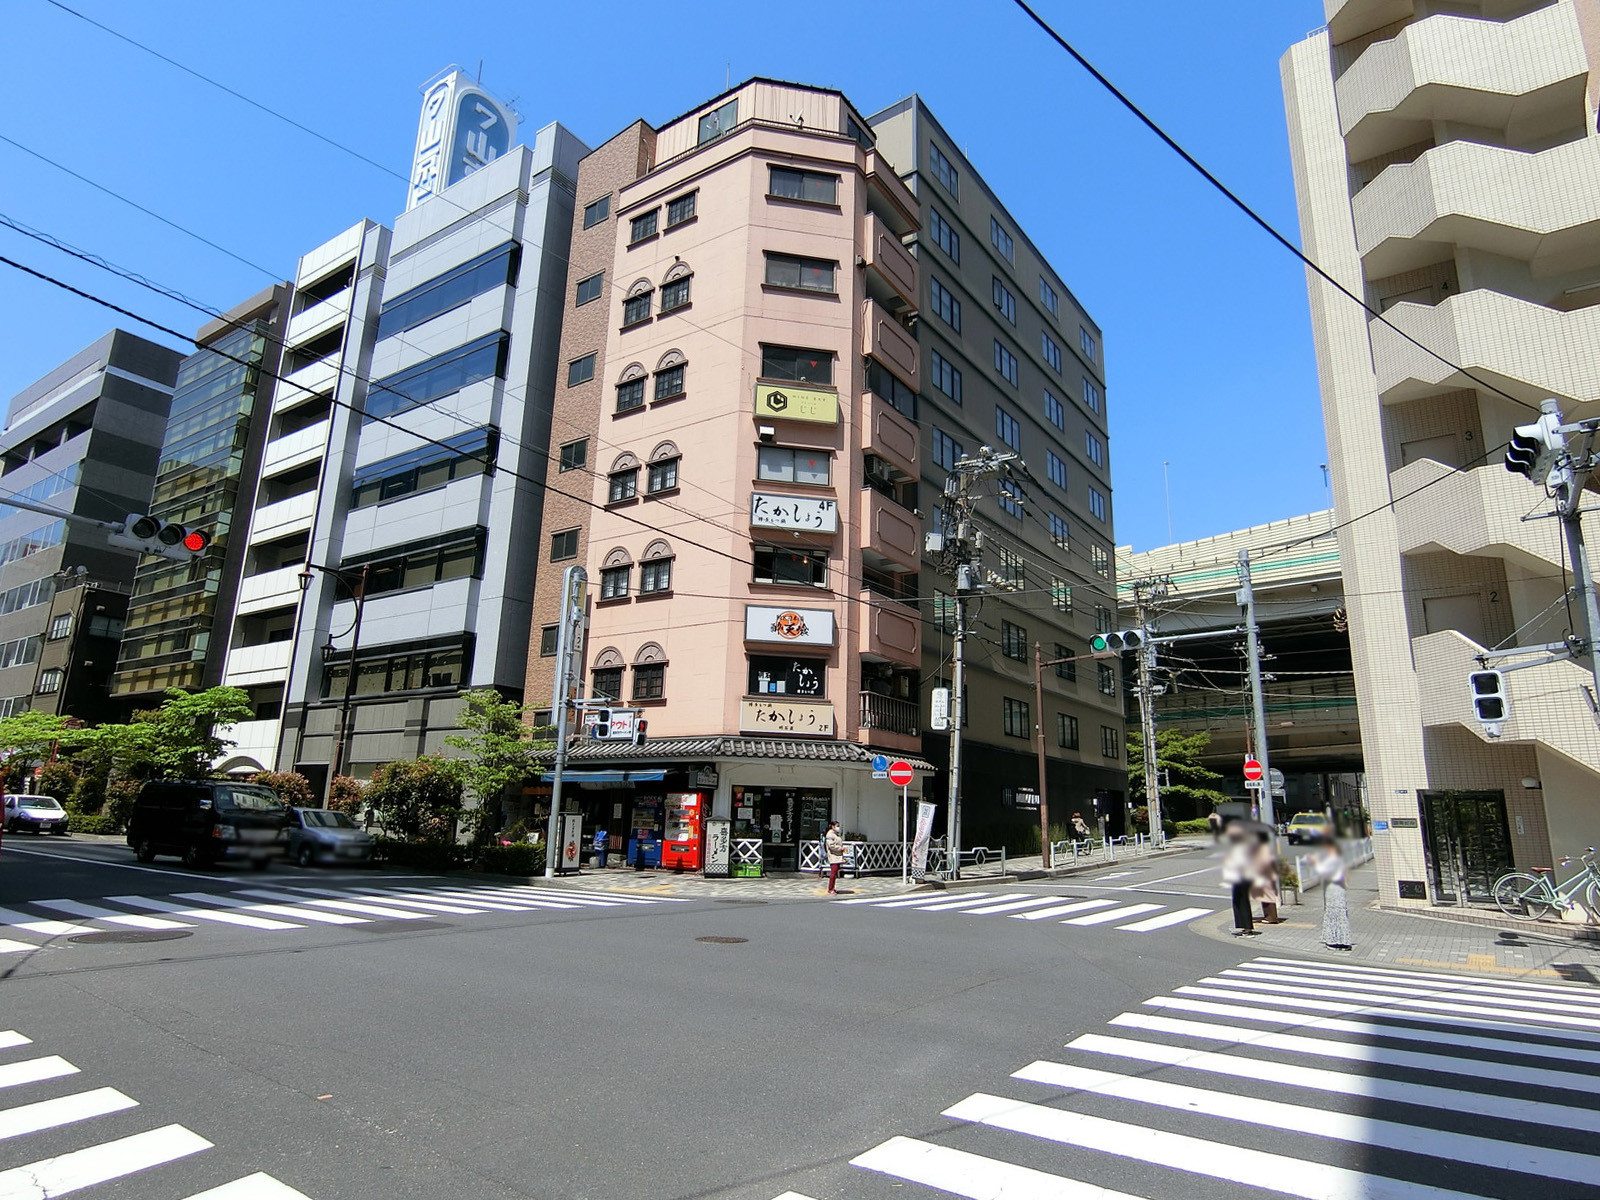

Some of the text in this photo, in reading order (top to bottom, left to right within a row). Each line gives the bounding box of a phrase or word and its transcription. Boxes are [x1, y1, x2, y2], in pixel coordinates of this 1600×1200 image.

[1441, 281, 1449, 291] 4
[1464, 430, 1474, 441] 3
[754, 496, 823, 528] たかしょう
[818, 501, 833, 511] 4F
[1490, 591, 1498, 603] 2
[792, 661, 813, 675] たか
[799, 674, 819, 690] しょう
[755, 708, 816, 726] たかしょう
[818, 724, 829, 732] 2F
[719, 827, 728, 853] 喜多方
[711, 833, 719, 863] ラーメン
